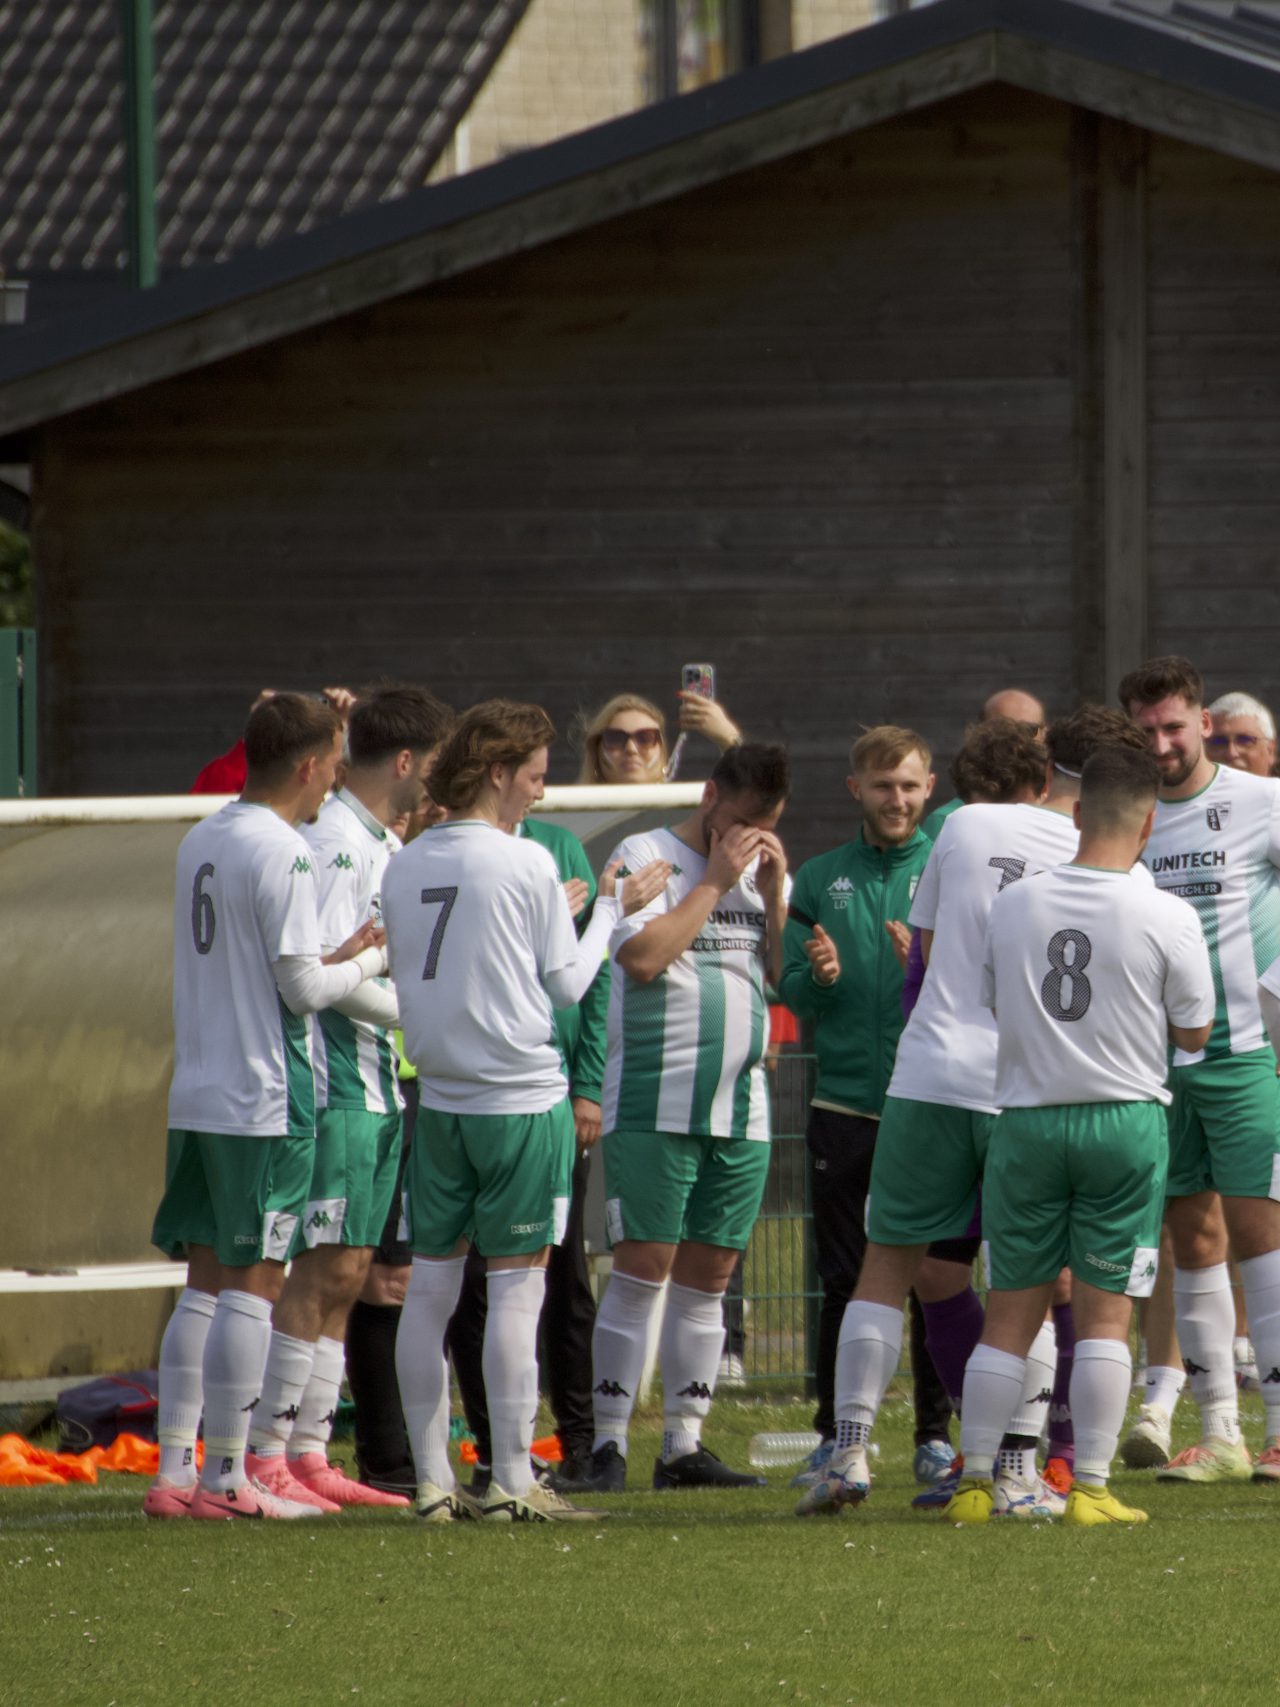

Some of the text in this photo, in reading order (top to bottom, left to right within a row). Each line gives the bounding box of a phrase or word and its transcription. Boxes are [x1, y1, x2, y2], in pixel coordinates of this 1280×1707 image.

[191, 862, 216, 954] 6
[1152, 851, 1226, 872] UNITECH
[420, 885, 458, 981] 7
[1041, 928, 1092, 1022] 8
